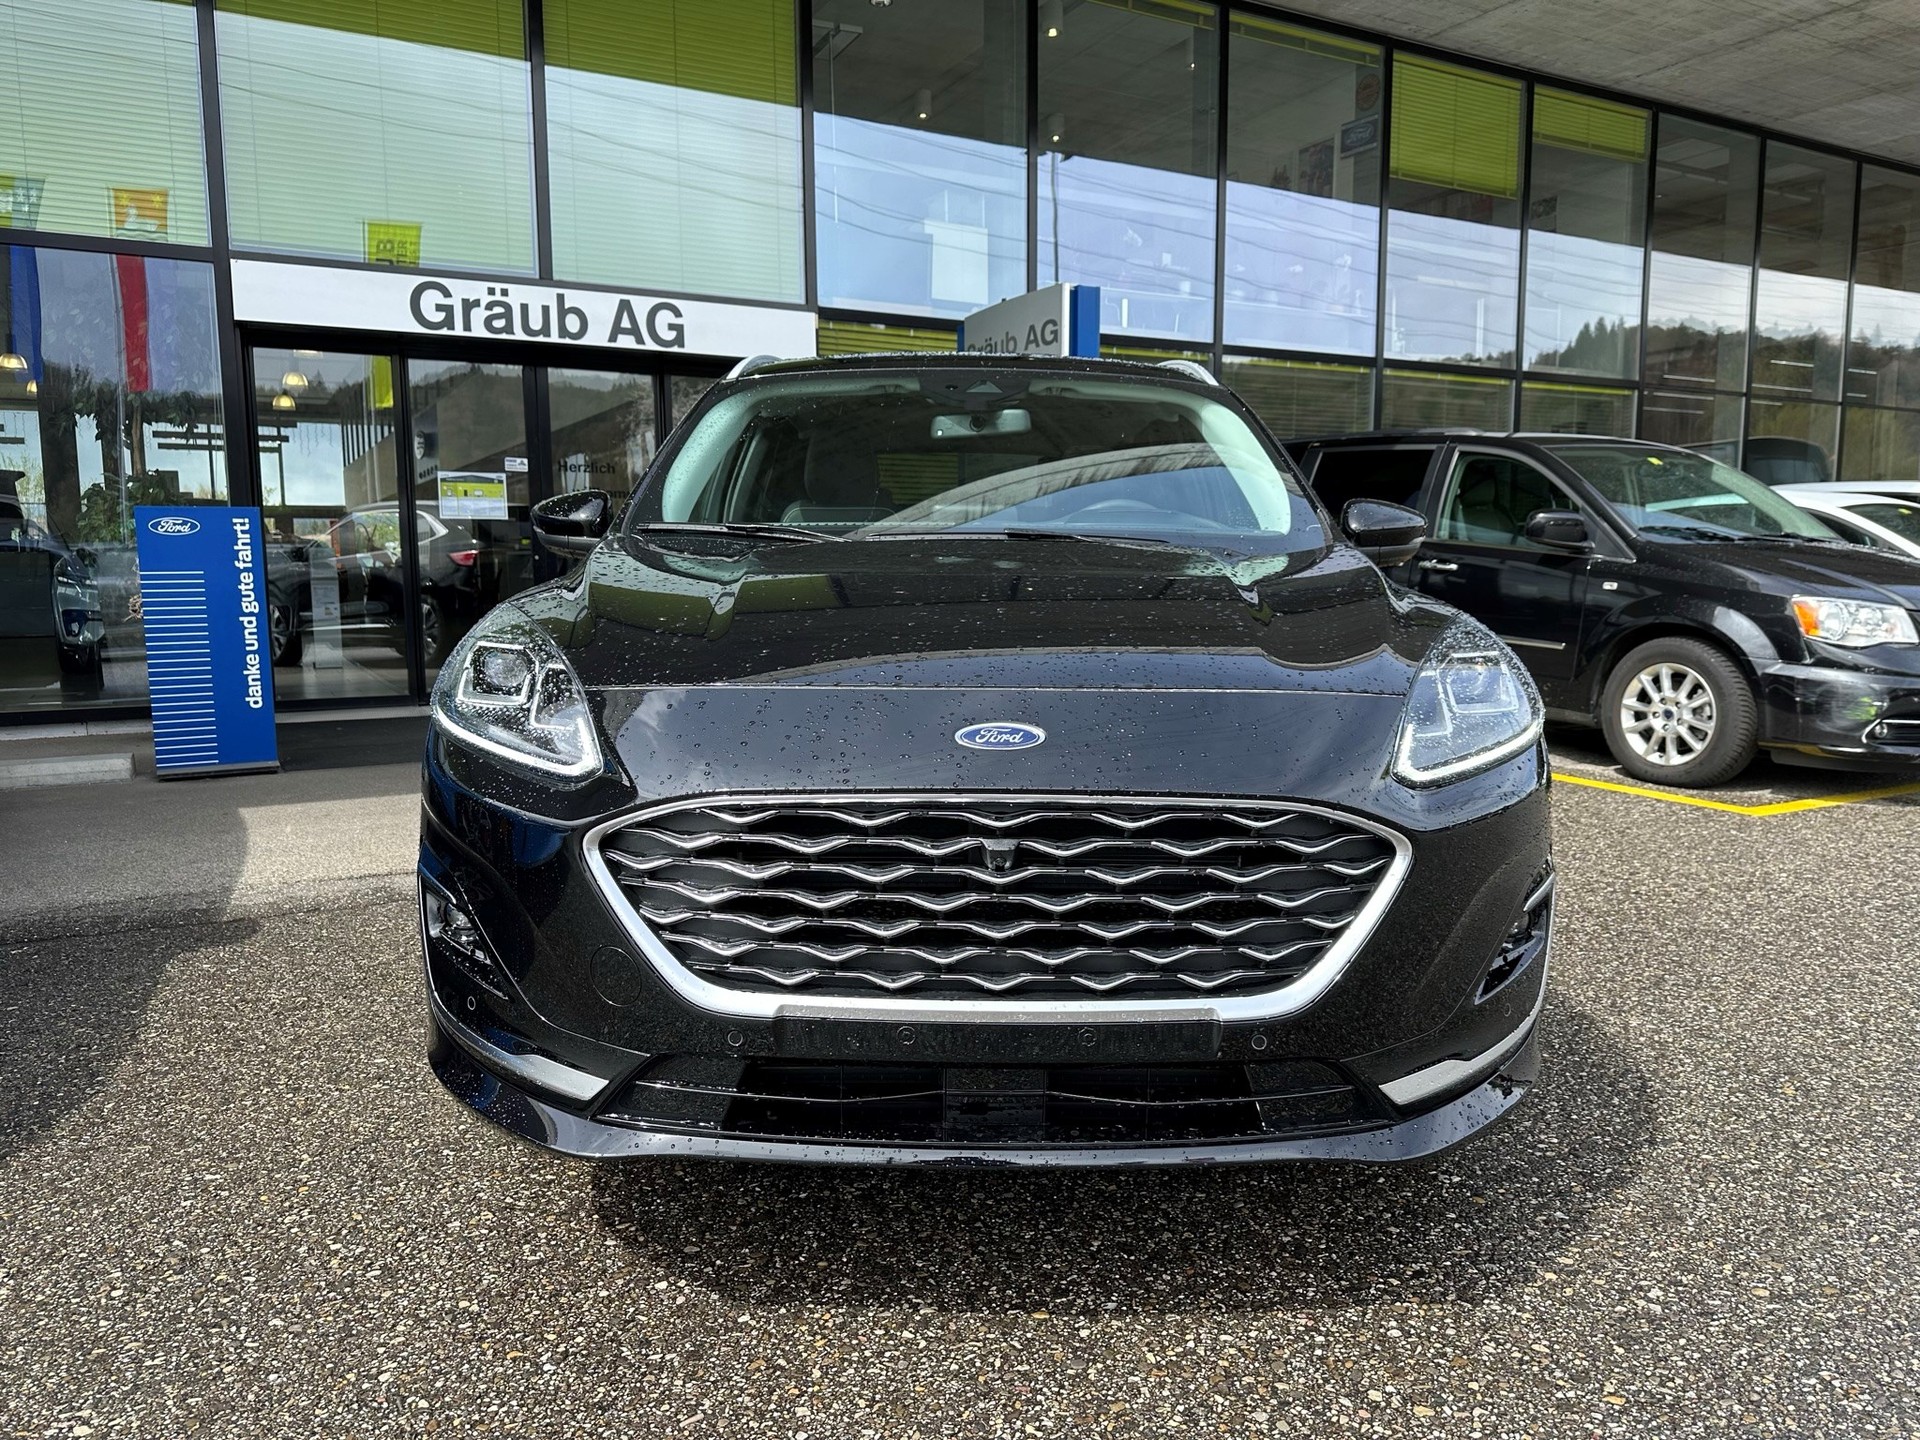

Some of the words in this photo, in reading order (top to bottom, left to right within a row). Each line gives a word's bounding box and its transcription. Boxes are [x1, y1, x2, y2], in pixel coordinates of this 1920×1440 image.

[409, 280, 589, 341] Gräub
[607, 298, 686, 349] AG
[1024, 318, 1059, 351] AG
[557, 460, 616, 474] Herzlich
[157, 519, 192, 533] Ford
[232, 517, 253, 570] fahrt!
[237, 571, 260, 614] gute
[239, 616, 258, 651] und
[243, 653, 263, 709] danke
[975, 727, 1024, 743] Ford
